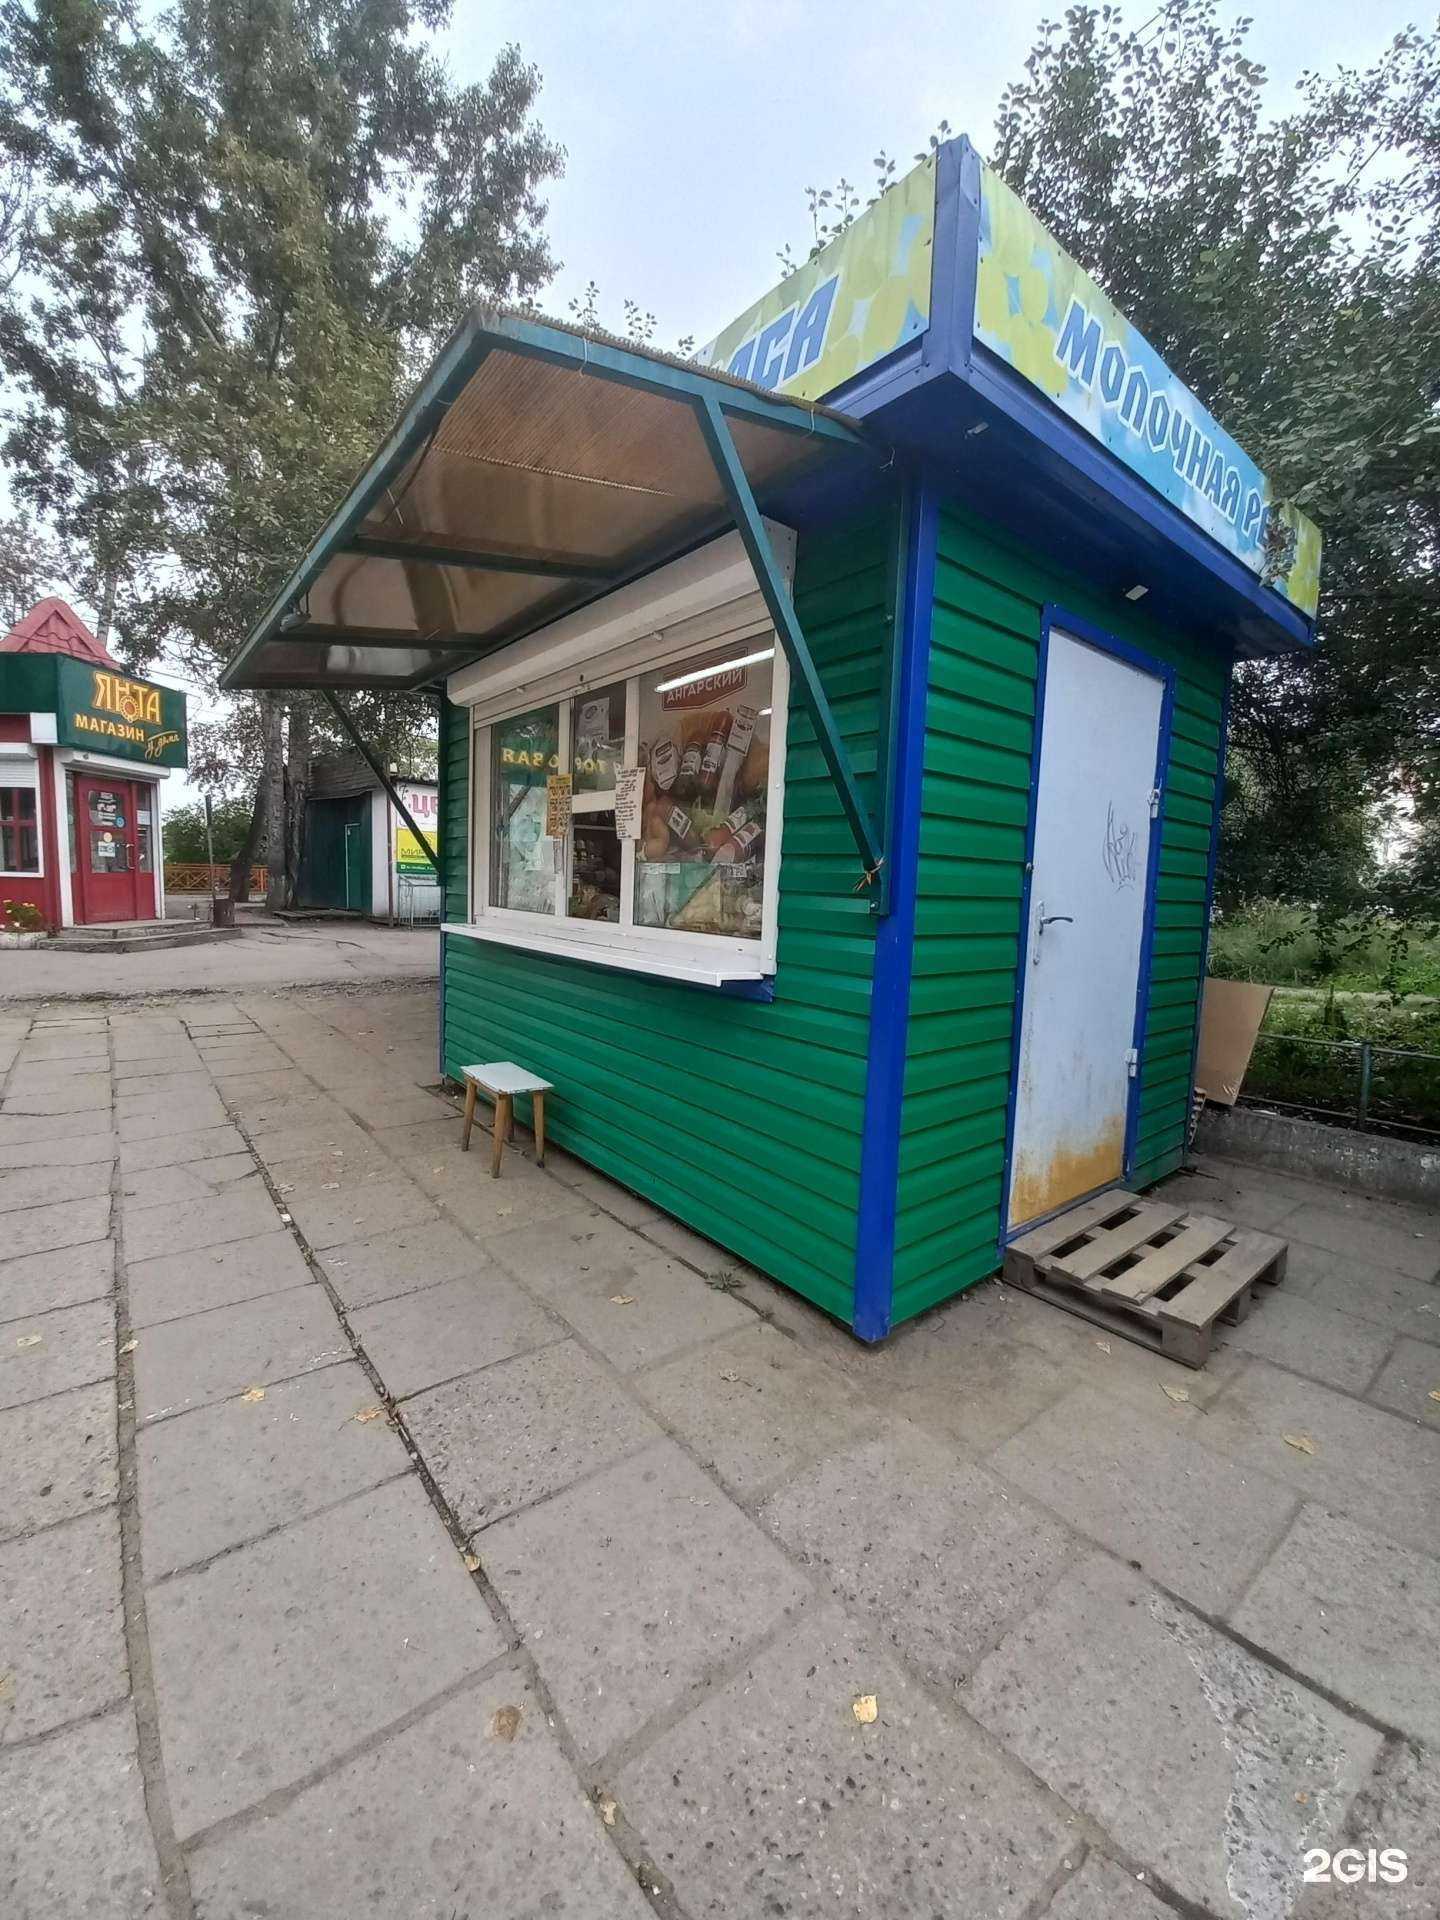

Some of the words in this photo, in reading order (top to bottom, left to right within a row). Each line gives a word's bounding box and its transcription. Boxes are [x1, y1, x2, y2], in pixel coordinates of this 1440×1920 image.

[1055, 297, 1241, 524] МОЛОЧНАЯ
[93, 672, 161, 724] ЯНТА
[667, 668, 743, 704] АНГАРСКИЙ
[75, 713, 145, 742] МАГАЗИН
